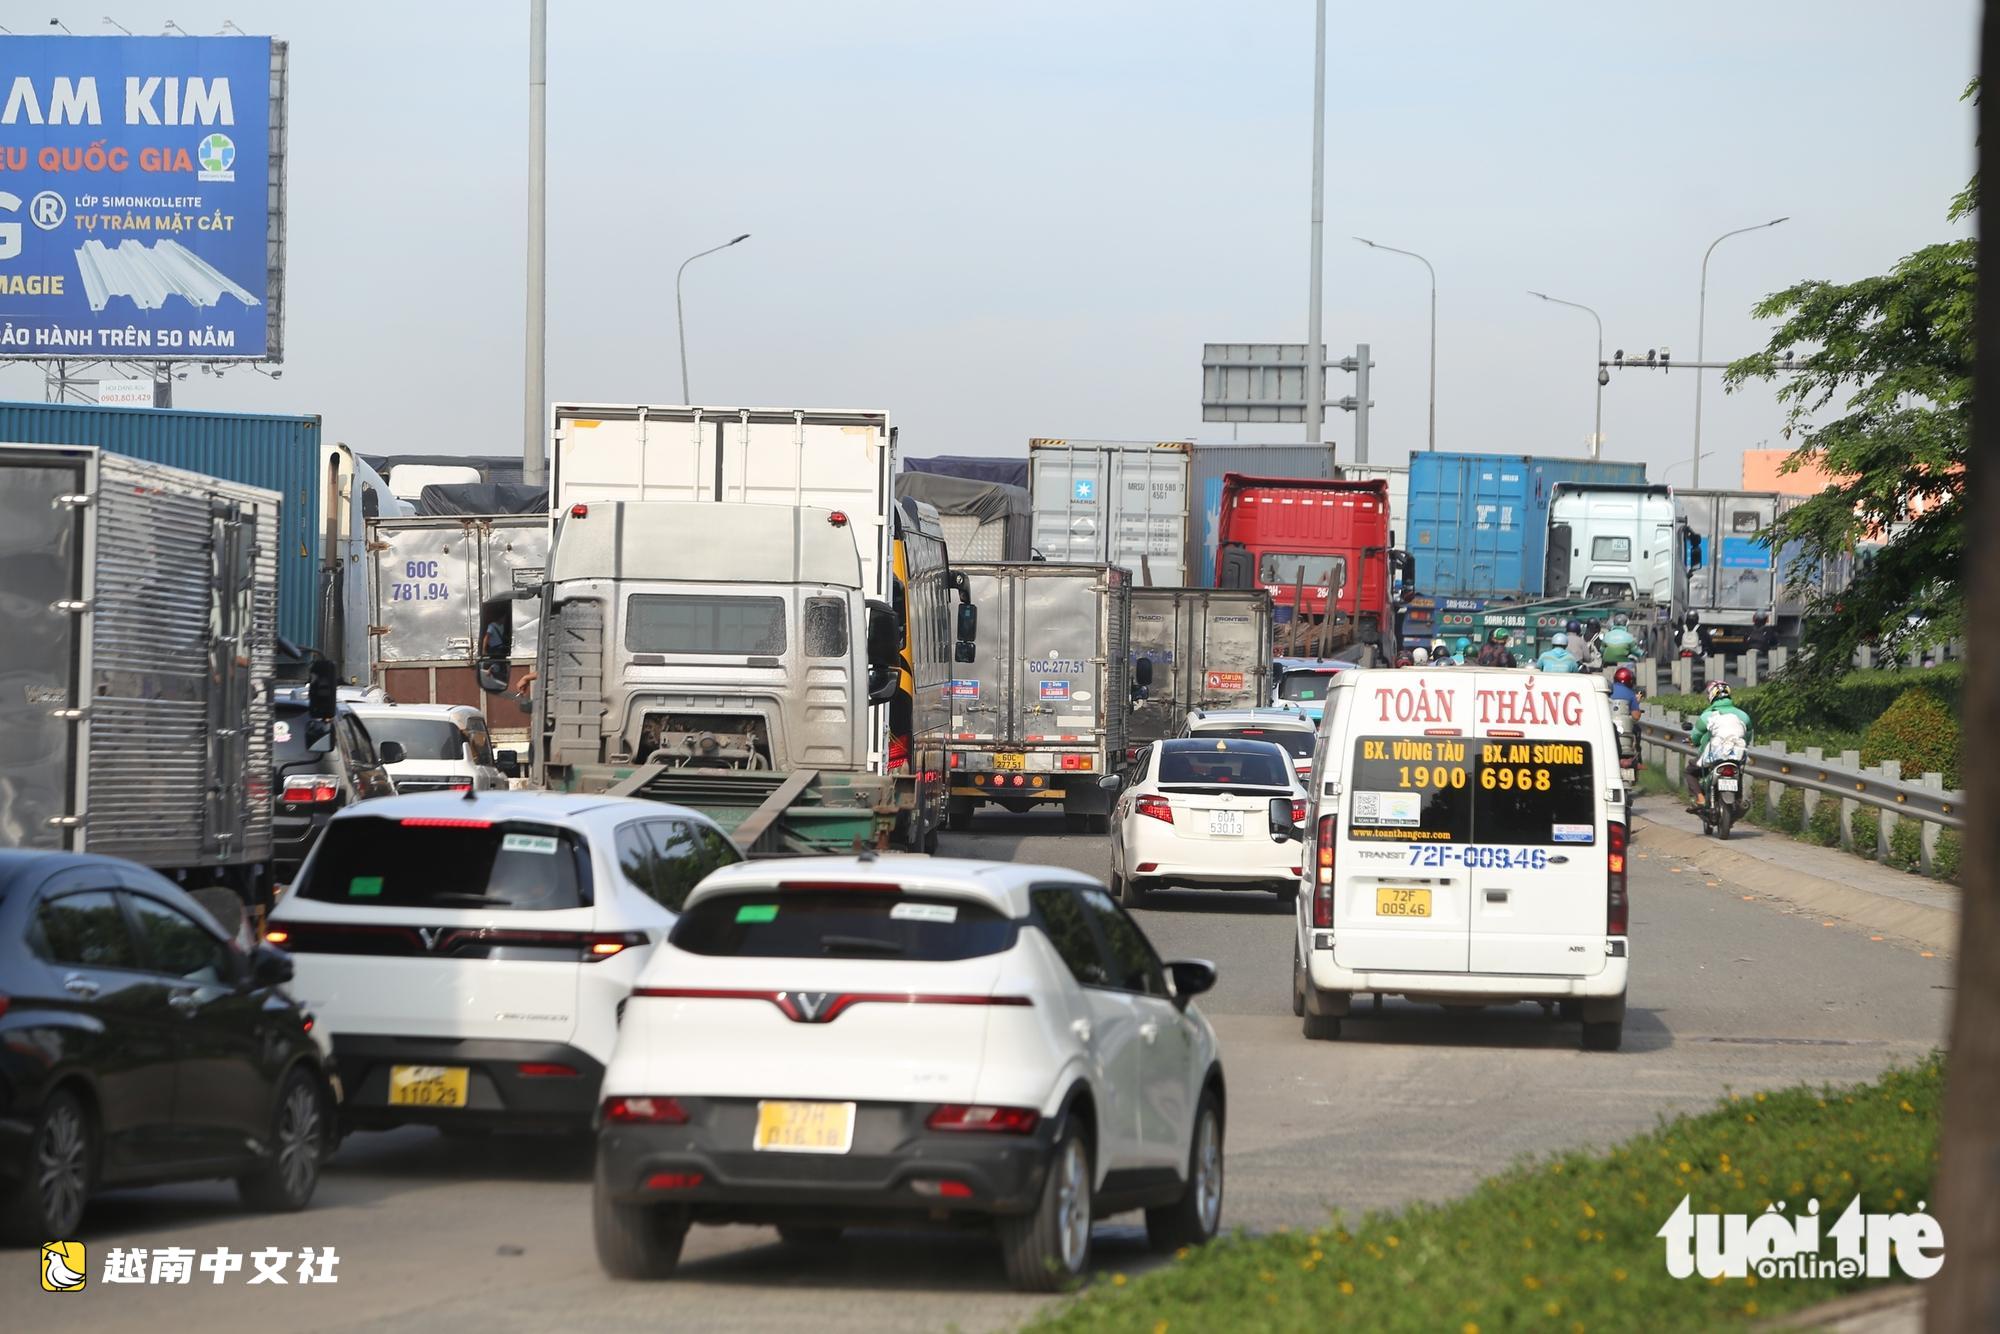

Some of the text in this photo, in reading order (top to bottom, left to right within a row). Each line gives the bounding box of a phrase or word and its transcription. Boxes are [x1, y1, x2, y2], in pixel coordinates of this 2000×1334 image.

[125, 76, 235, 125] KIM
[0, 138, 194, 174] U QUỐC GIA
[75, 194, 202, 208] LỚP SIMONKOLLEITE
[75, 213, 97, 233] TỰ
[155, 212, 194, 234] MẶT
[198, 208, 234, 231] CẮT
[0, 322, 235, 347] ẢO HÀNH TRÊN 50 NĂM
[405, 560, 439, 579] 60C
[391, 582, 449, 601] 781.94
[1029, 660, 1085, 673] 60C.277.51
[1375, 675, 1584, 726] TOÀN THẮNG
[1002, 754, 1017, 762] 60C
[1363, 739, 1465, 762] BX. VŨNG TÀU
[1482, 744, 1584, 765] BX. AN SƯƠNG
[1399, 766, 1551, 792] 1900 6968
[1352, 828, 1451, 841] www.toanthangcar.com
[1358, 850, 1407, 859] TRANSIT
[1392, 890, 1417, 902] 72F
[1382, 902, 1425, 915] 009.46
